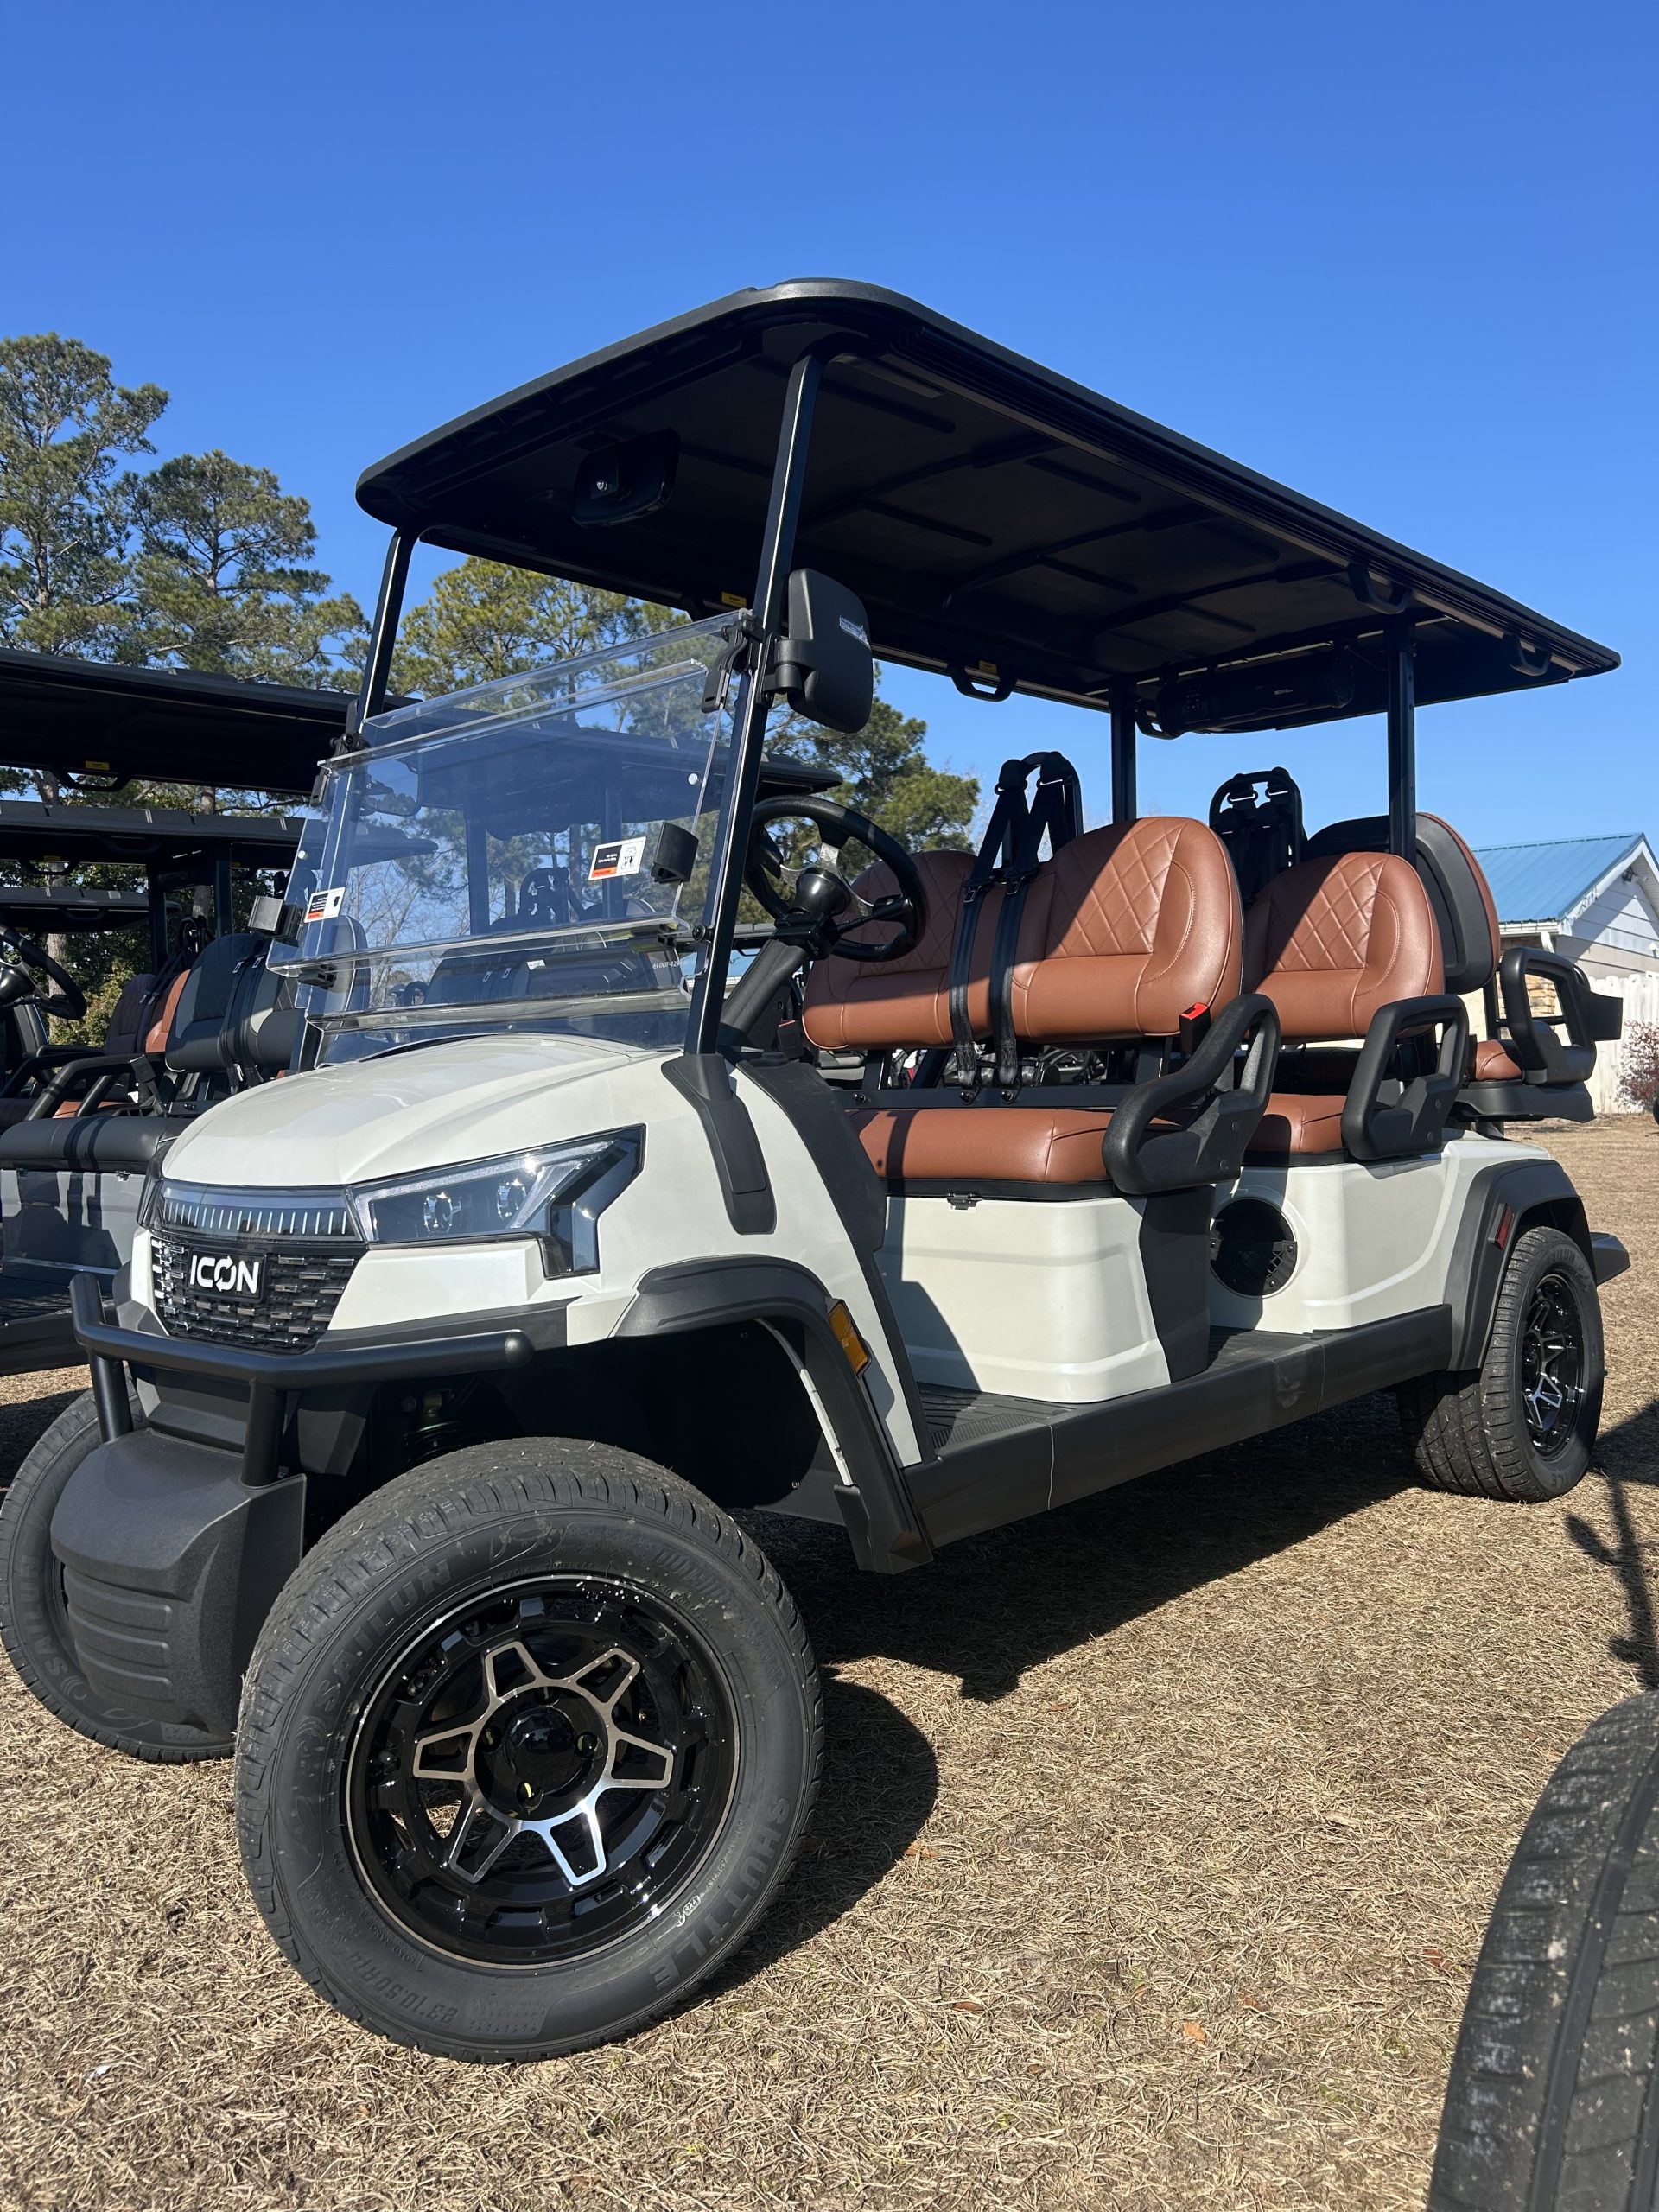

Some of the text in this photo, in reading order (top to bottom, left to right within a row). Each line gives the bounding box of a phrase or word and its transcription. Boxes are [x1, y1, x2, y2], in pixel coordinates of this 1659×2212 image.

[189, 1255, 260, 1294] ICON
[315, 1558, 453, 1712] SAILUN
[649, 1795, 791, 1992] SHUTTLE
